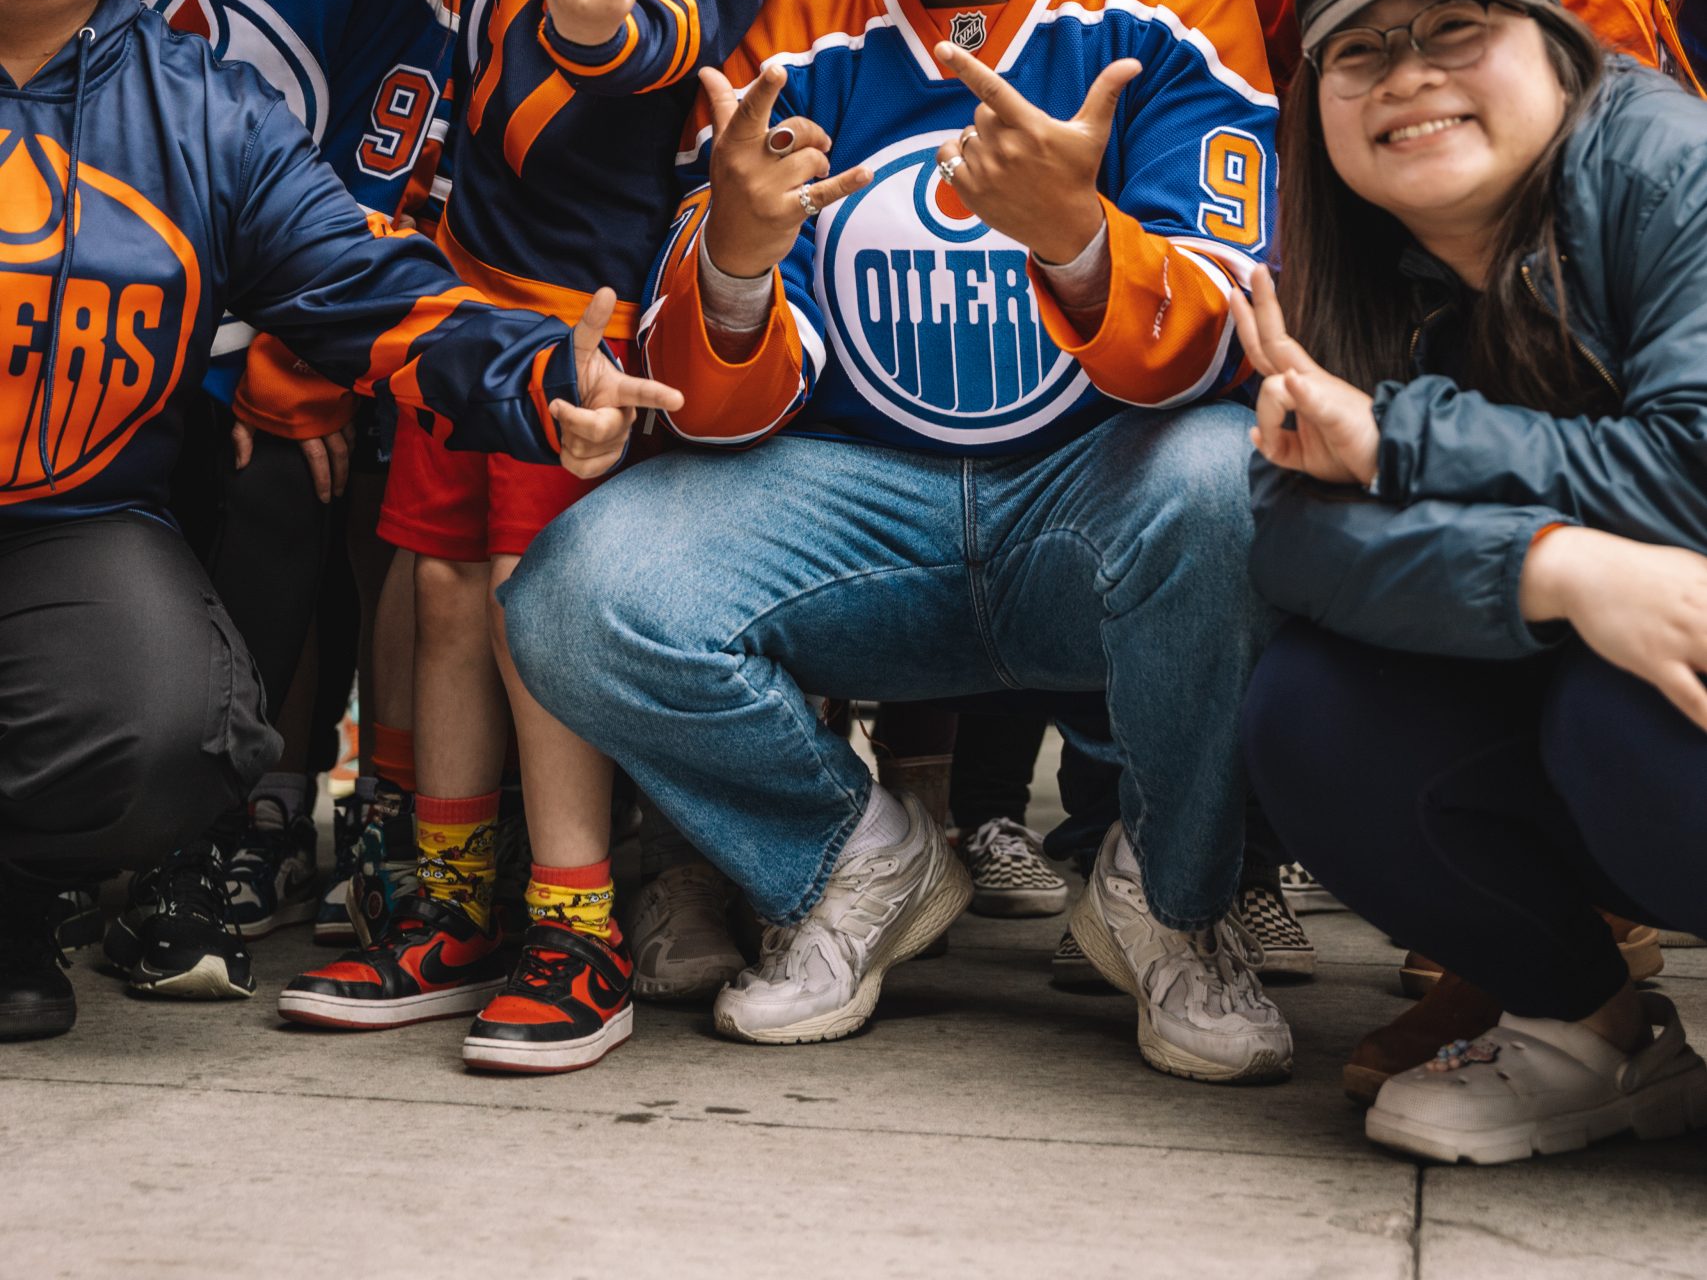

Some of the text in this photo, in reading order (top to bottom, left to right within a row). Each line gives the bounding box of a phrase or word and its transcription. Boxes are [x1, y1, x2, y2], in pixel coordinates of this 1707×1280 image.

[958, 20, 980, 45] NHL
[355, 63, 440, 181] 9
[1196, 125, 1267, 255] 9
[0, 270, 165, 488] ERS
[854, 248, 1062, 413] OILER
